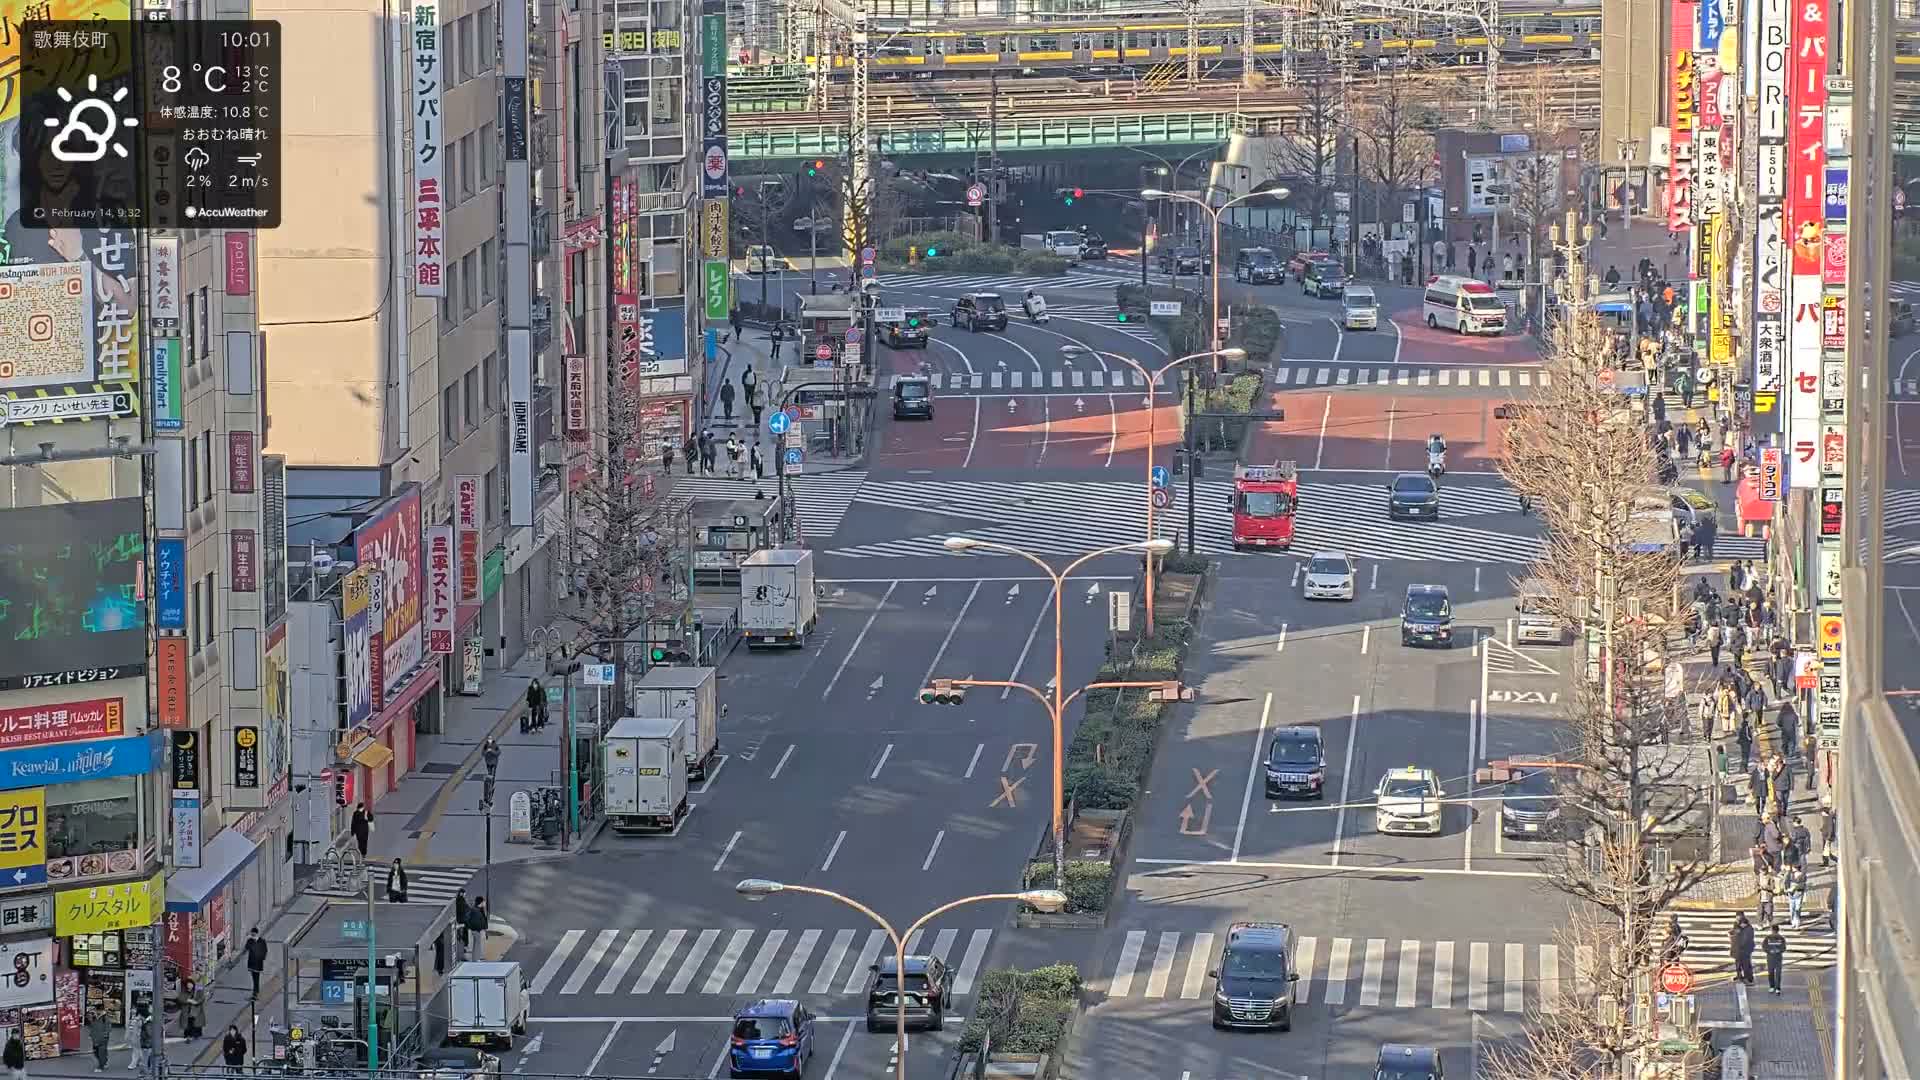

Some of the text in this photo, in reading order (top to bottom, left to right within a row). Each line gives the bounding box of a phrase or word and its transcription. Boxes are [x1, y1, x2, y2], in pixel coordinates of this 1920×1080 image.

[150, 11, 167, 21] 6F
[415, 5, 441, 286] 新宿サンパーク 三平本館
[710, 270, 723, 308] レイク
[1759, 324, 1773, 377] 大衆酒場
[156, 347, 168, 409] FamilyMart
[1794, 302, 1820, 463] パセラ
[12, 399, 110, 416] テンクリ たいせい先生
[460, 481, 471, 525] GAME
[432, 537, 448, 622] 三平ストア
[0, 710, 68, 733] ルコ料理
[0, 805, 38, 830] プロ
[0, 831, 40, 851] ミス
[3, 906, 38, 925] 囲碁
[69, 898, 141, 921] クリスタル
[326, 985, 341, 997] 12
